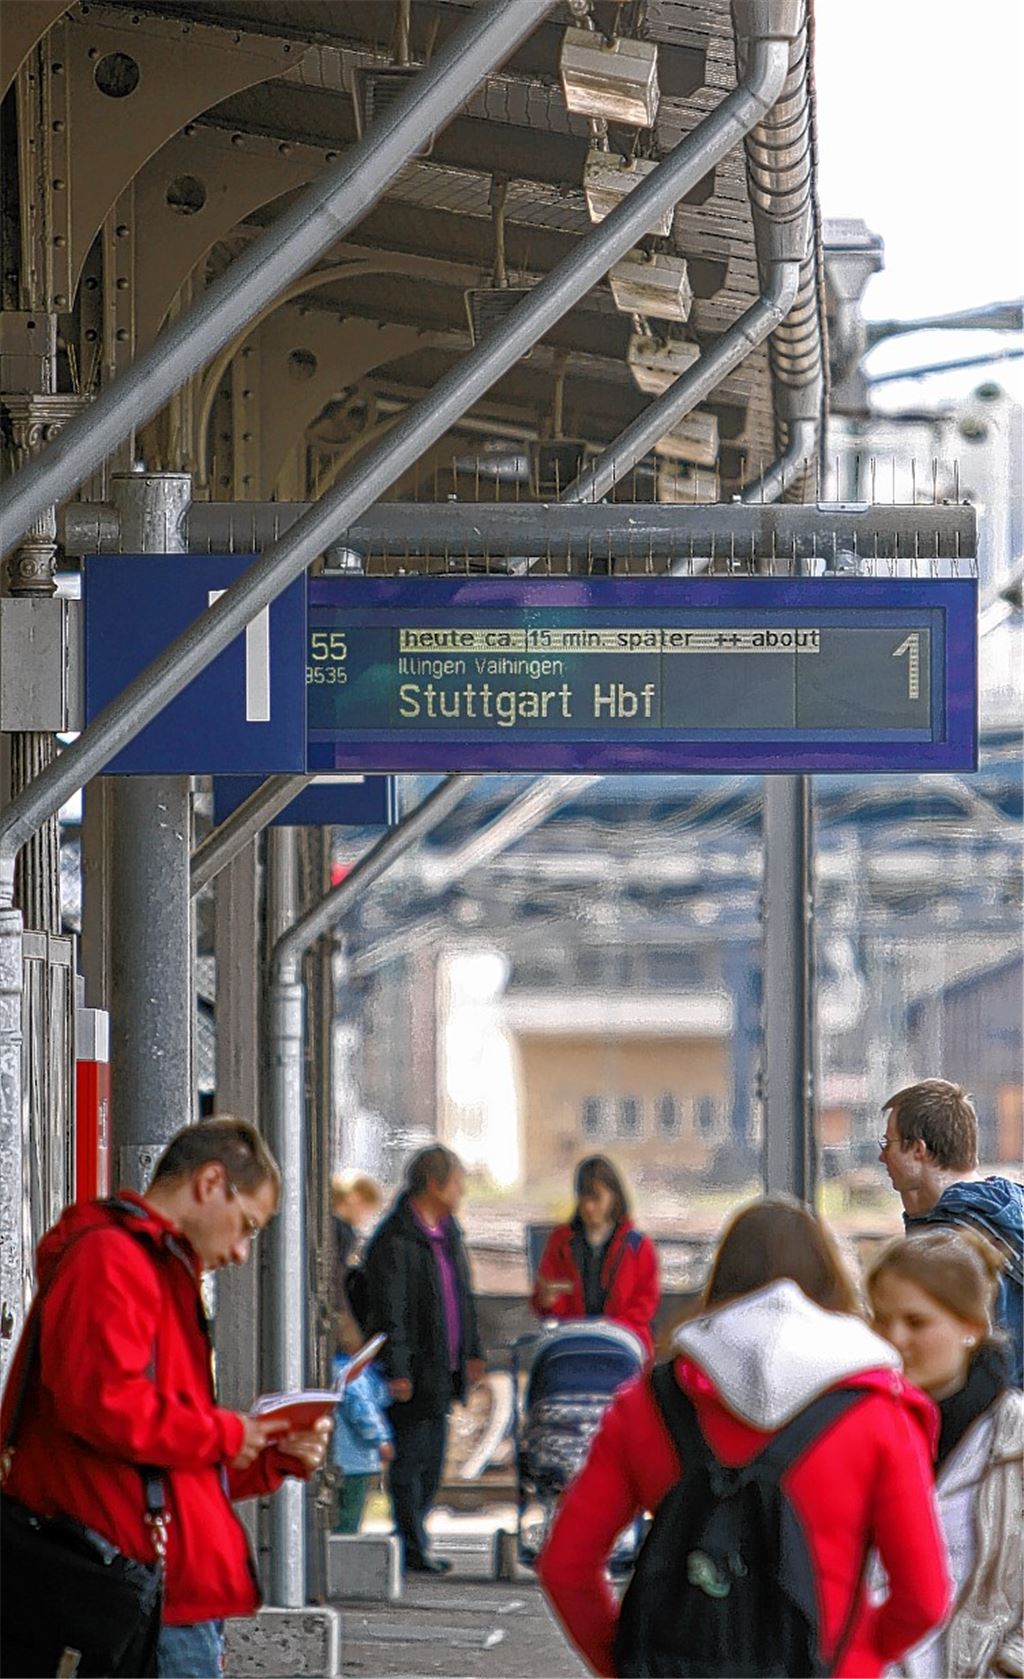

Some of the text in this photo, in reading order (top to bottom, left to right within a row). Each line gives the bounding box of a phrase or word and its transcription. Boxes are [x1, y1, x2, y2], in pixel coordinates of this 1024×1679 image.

[208, 589, 270, 721] 1
[312, 633, 347, 660] 55
[404, 630, 474, 647] heute
[485, 632, 516, 647] ca.
[529, 630, 551, 647] 15
[562, 630, 606, 647] min.
[617, 630, 693, 651] später
[752, 630, 819, 647] about
[398, 657, 563, 679] Illingen Vaihingen
[892, 632, 919, 699] 1
[400, 684, 655, 727] Stuttgart Hbf
